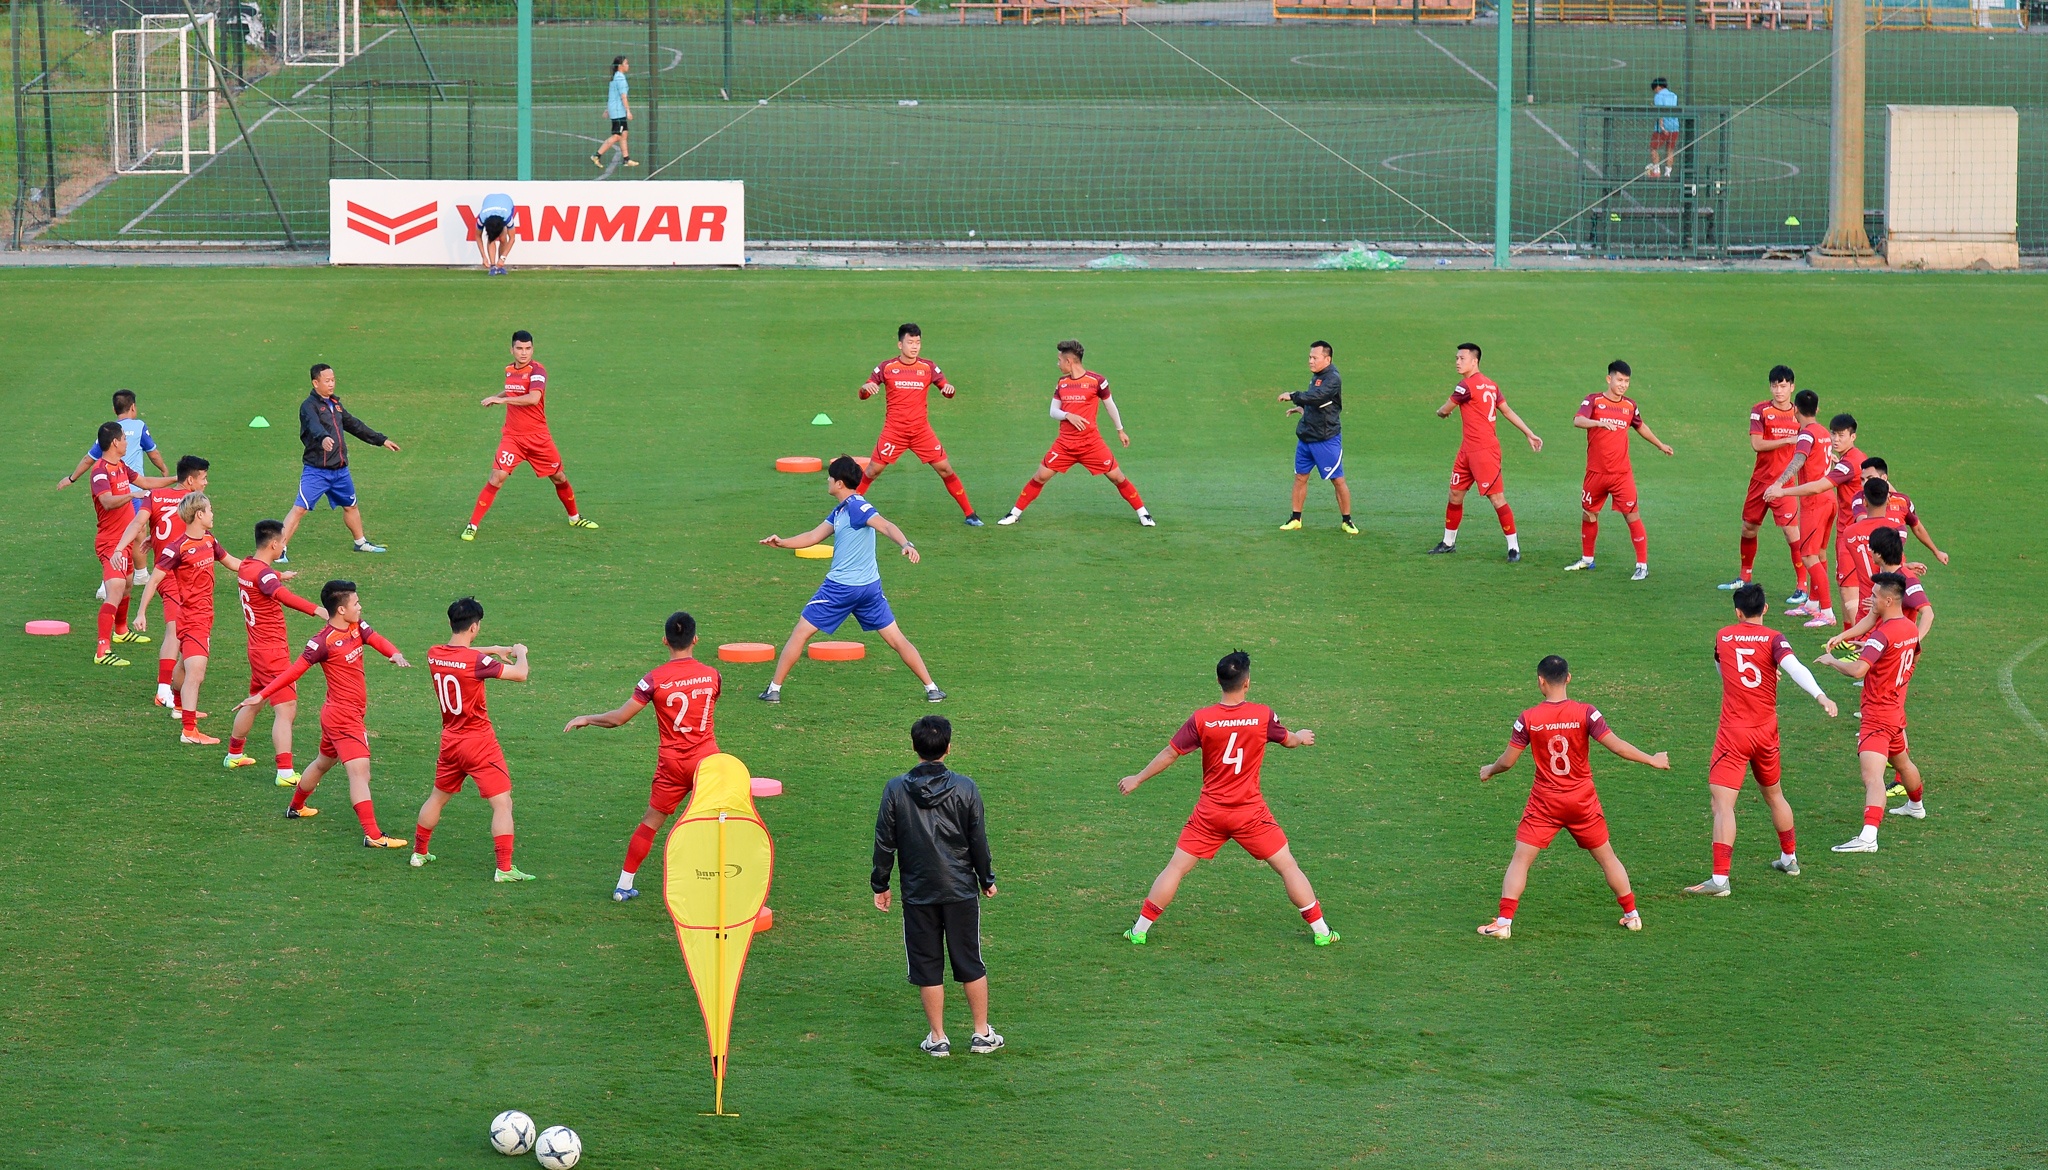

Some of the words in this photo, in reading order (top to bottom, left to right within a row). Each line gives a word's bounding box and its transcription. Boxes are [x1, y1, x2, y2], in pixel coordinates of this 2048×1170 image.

[881, 443, 895, 457] 21
[1048, 451, 1059, 463] 7
[499, 451, 515, 467] 39
[156, 506, 178, 540] 3
[1734, 634, 1770, 643] YANMAR
[434, 658, 467, 670] YANMAR
[1735, 647, 1762, 688] 5
[674, 676, 712, 687] YANMAR
[433, 672, 463, 715] 10
[666, 687, 713, 733] 27
[1217, 718, 1259, 728] YANMAR
[1545, 722, 1580, 730] YANMAR
[1222, 732, 1243, 775] 4
[1547, 734, 1571, 776] 8
